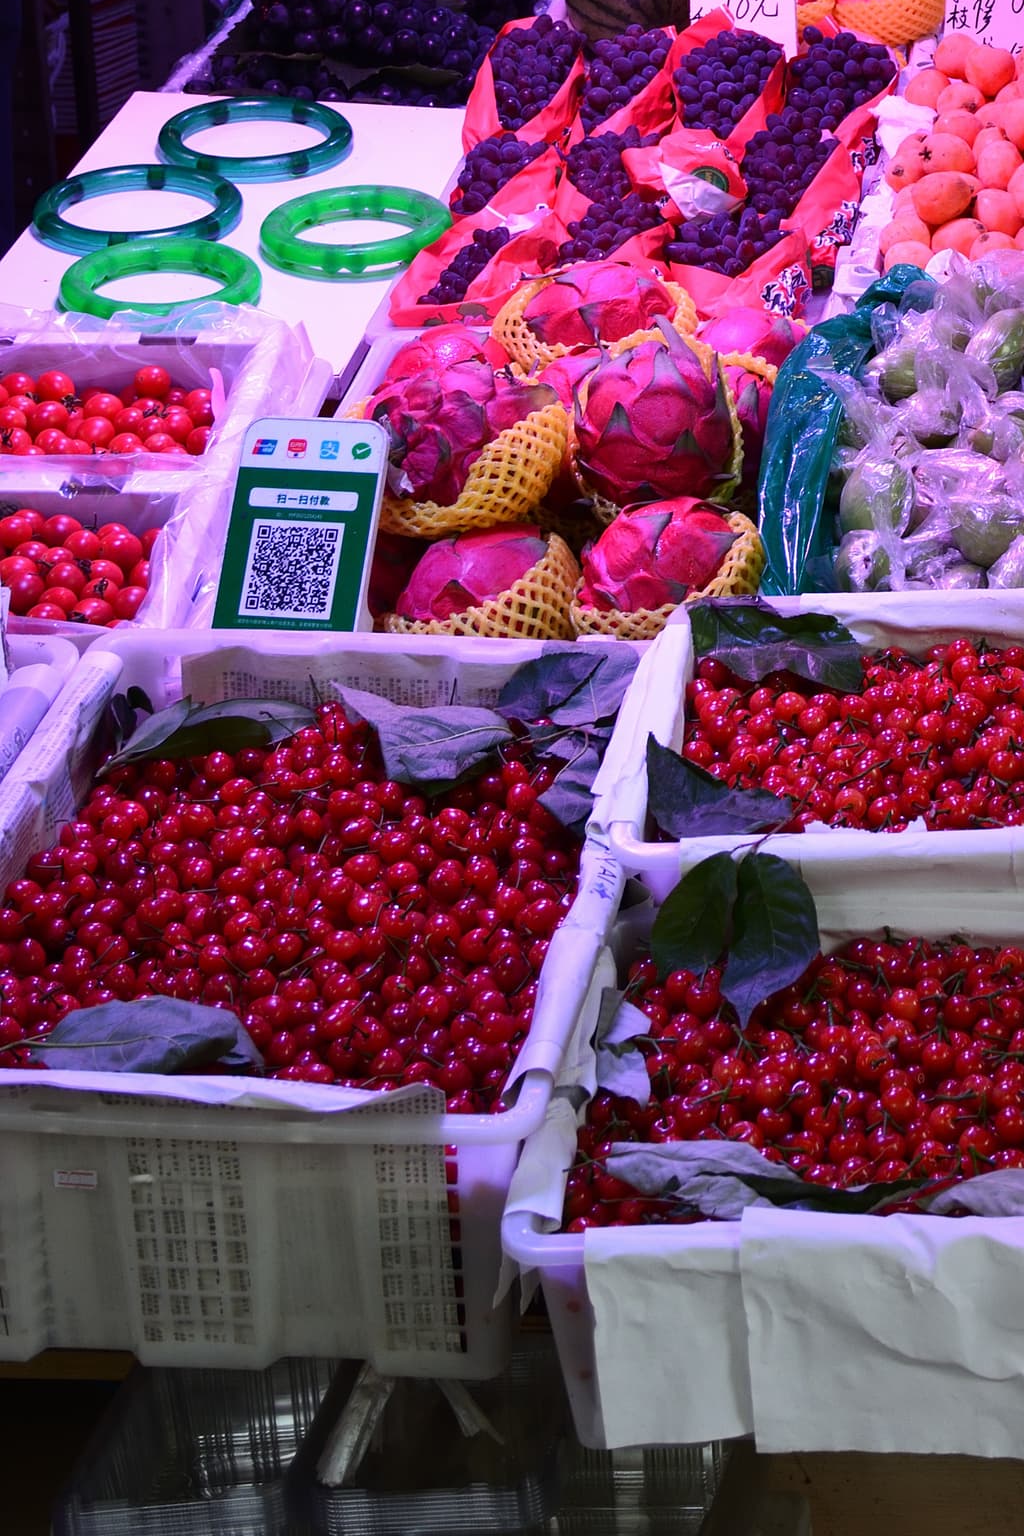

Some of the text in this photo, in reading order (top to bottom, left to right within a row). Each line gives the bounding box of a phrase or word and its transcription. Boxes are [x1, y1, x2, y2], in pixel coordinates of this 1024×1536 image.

[276, 493, 331, 506] 扫一扫付款
